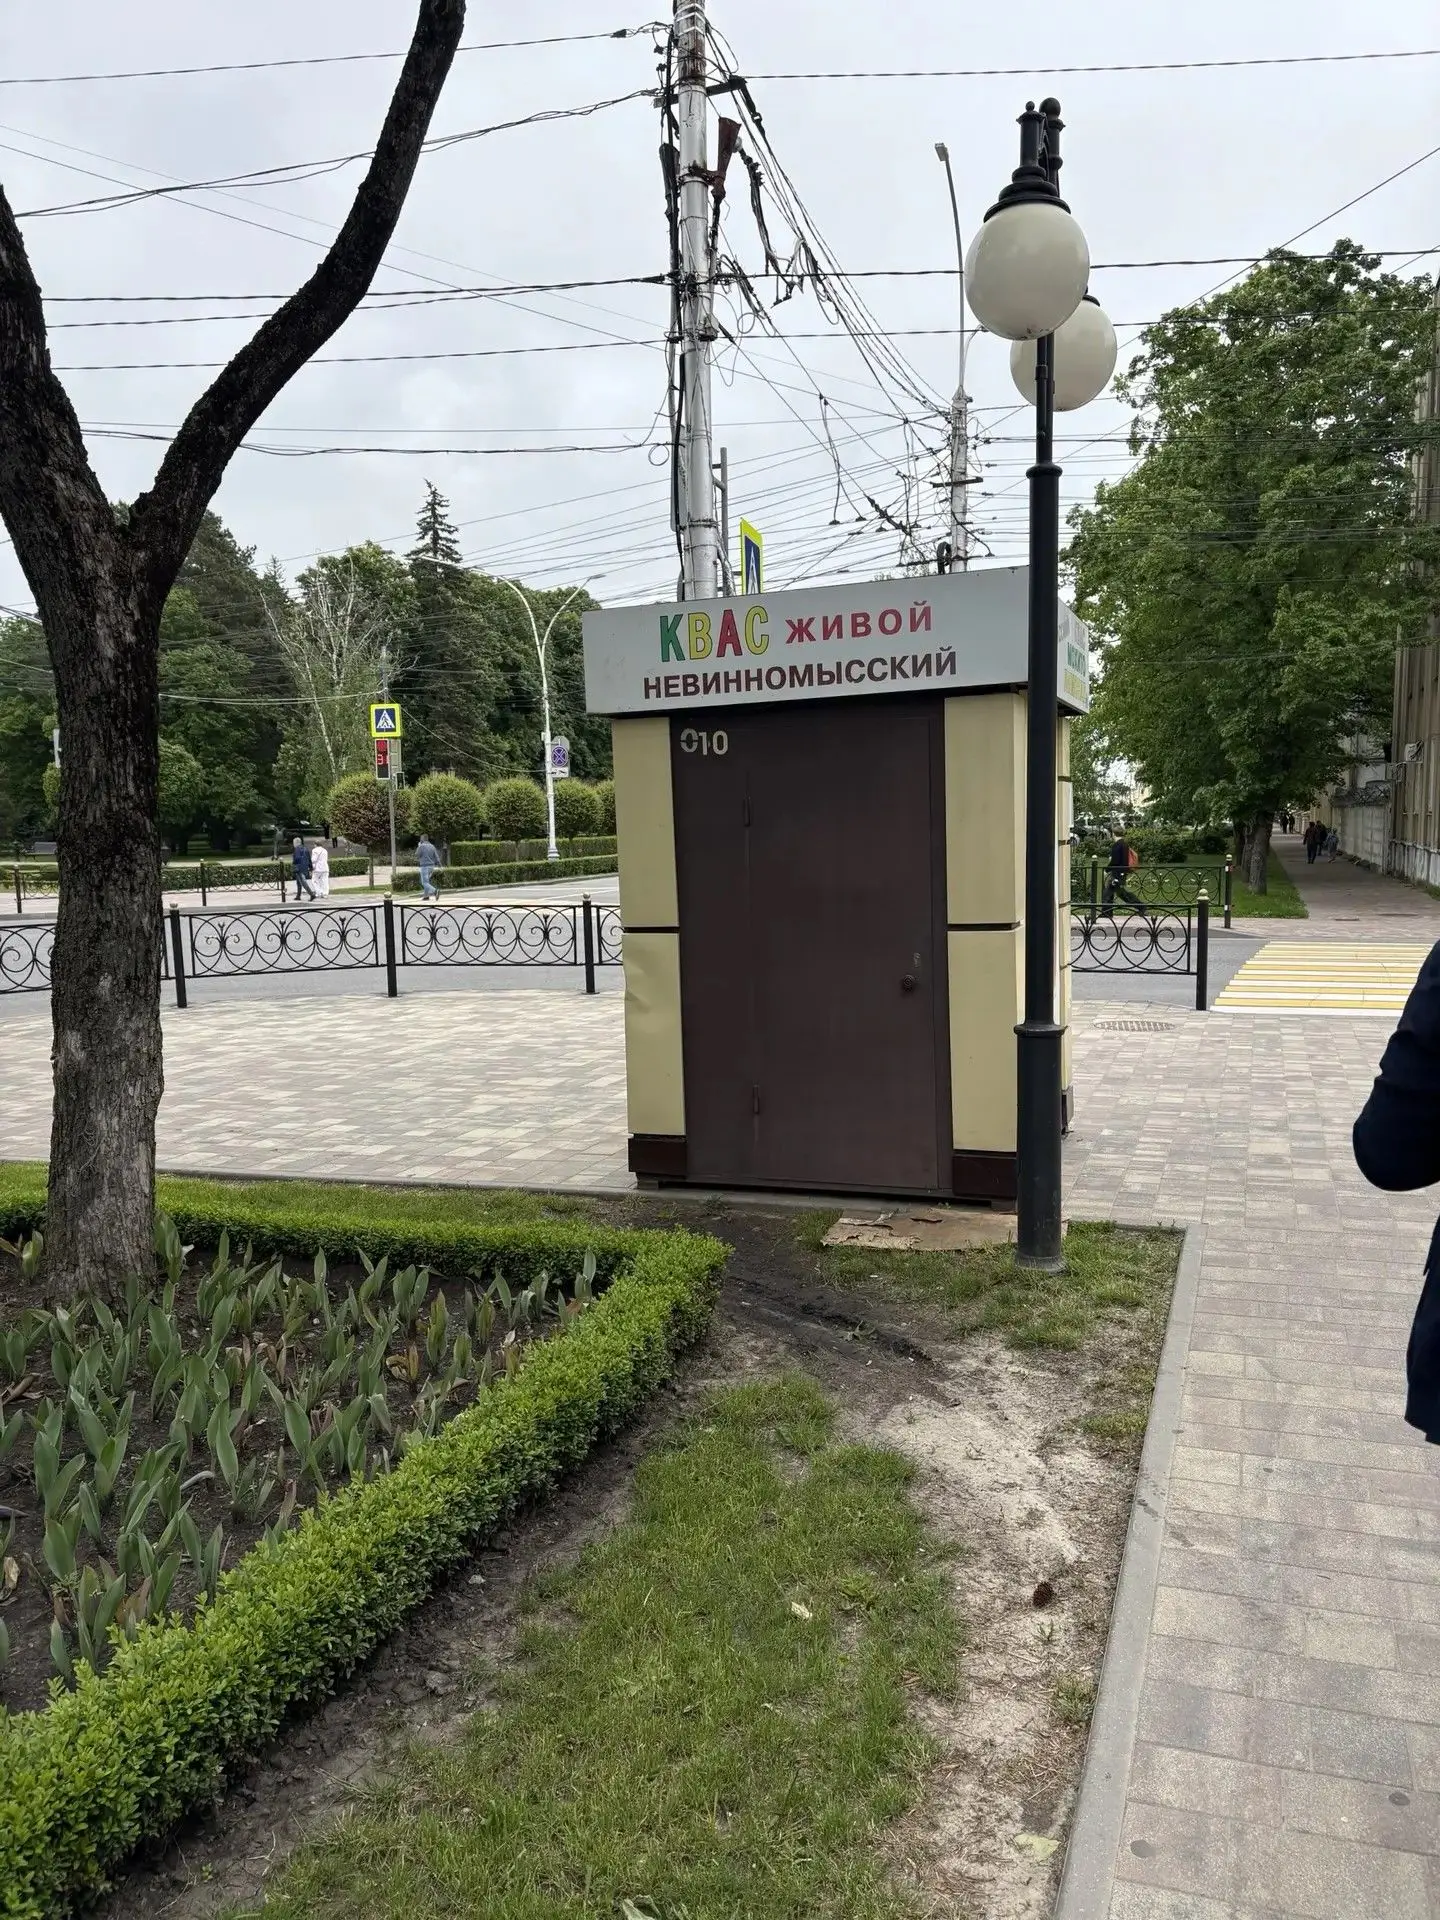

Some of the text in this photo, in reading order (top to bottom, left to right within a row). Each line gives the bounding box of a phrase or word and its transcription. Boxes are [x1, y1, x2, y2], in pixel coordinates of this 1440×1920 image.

[660, 600, 932, 662] КВАС ЖИВОЙ
[643, 645, 957, 699] НЕВИННОМЫССКИЙ
